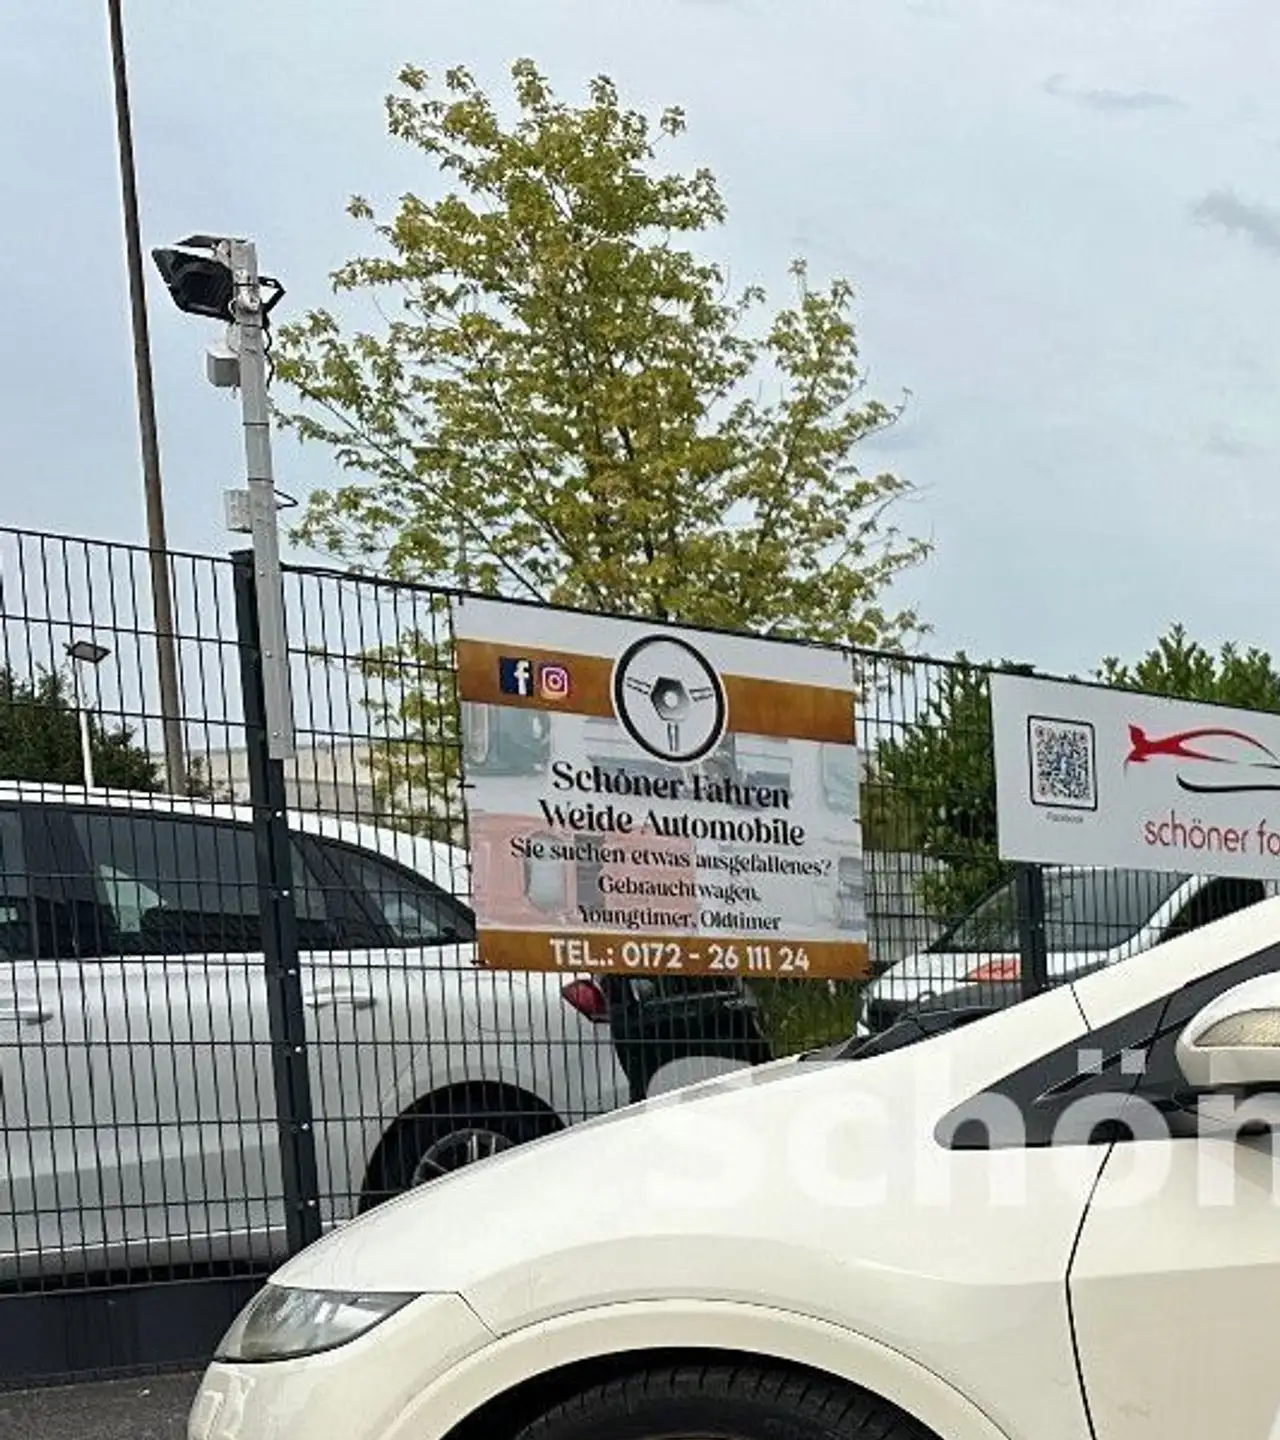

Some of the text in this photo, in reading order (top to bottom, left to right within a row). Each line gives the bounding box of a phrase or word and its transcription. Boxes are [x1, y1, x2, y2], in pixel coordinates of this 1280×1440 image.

[551, 760, 791, 810] Schöner Fahren
[538, 799, 806, 846] Weide Automobile
[1143, 808, 1249, 853] schöner
[509, 835, 832, 877] Sie suchen etwas ausgefallenes?
[577, 904, 781, 931] Youngtimer, Oldtimer
[548, 938, 614, 967] TEL.:
[620, 940, 683, 969] 0172
[707, 943, 740, 971] 26
[747, 945, 772, 971] 111
[778, 945, 810, 972] 24
